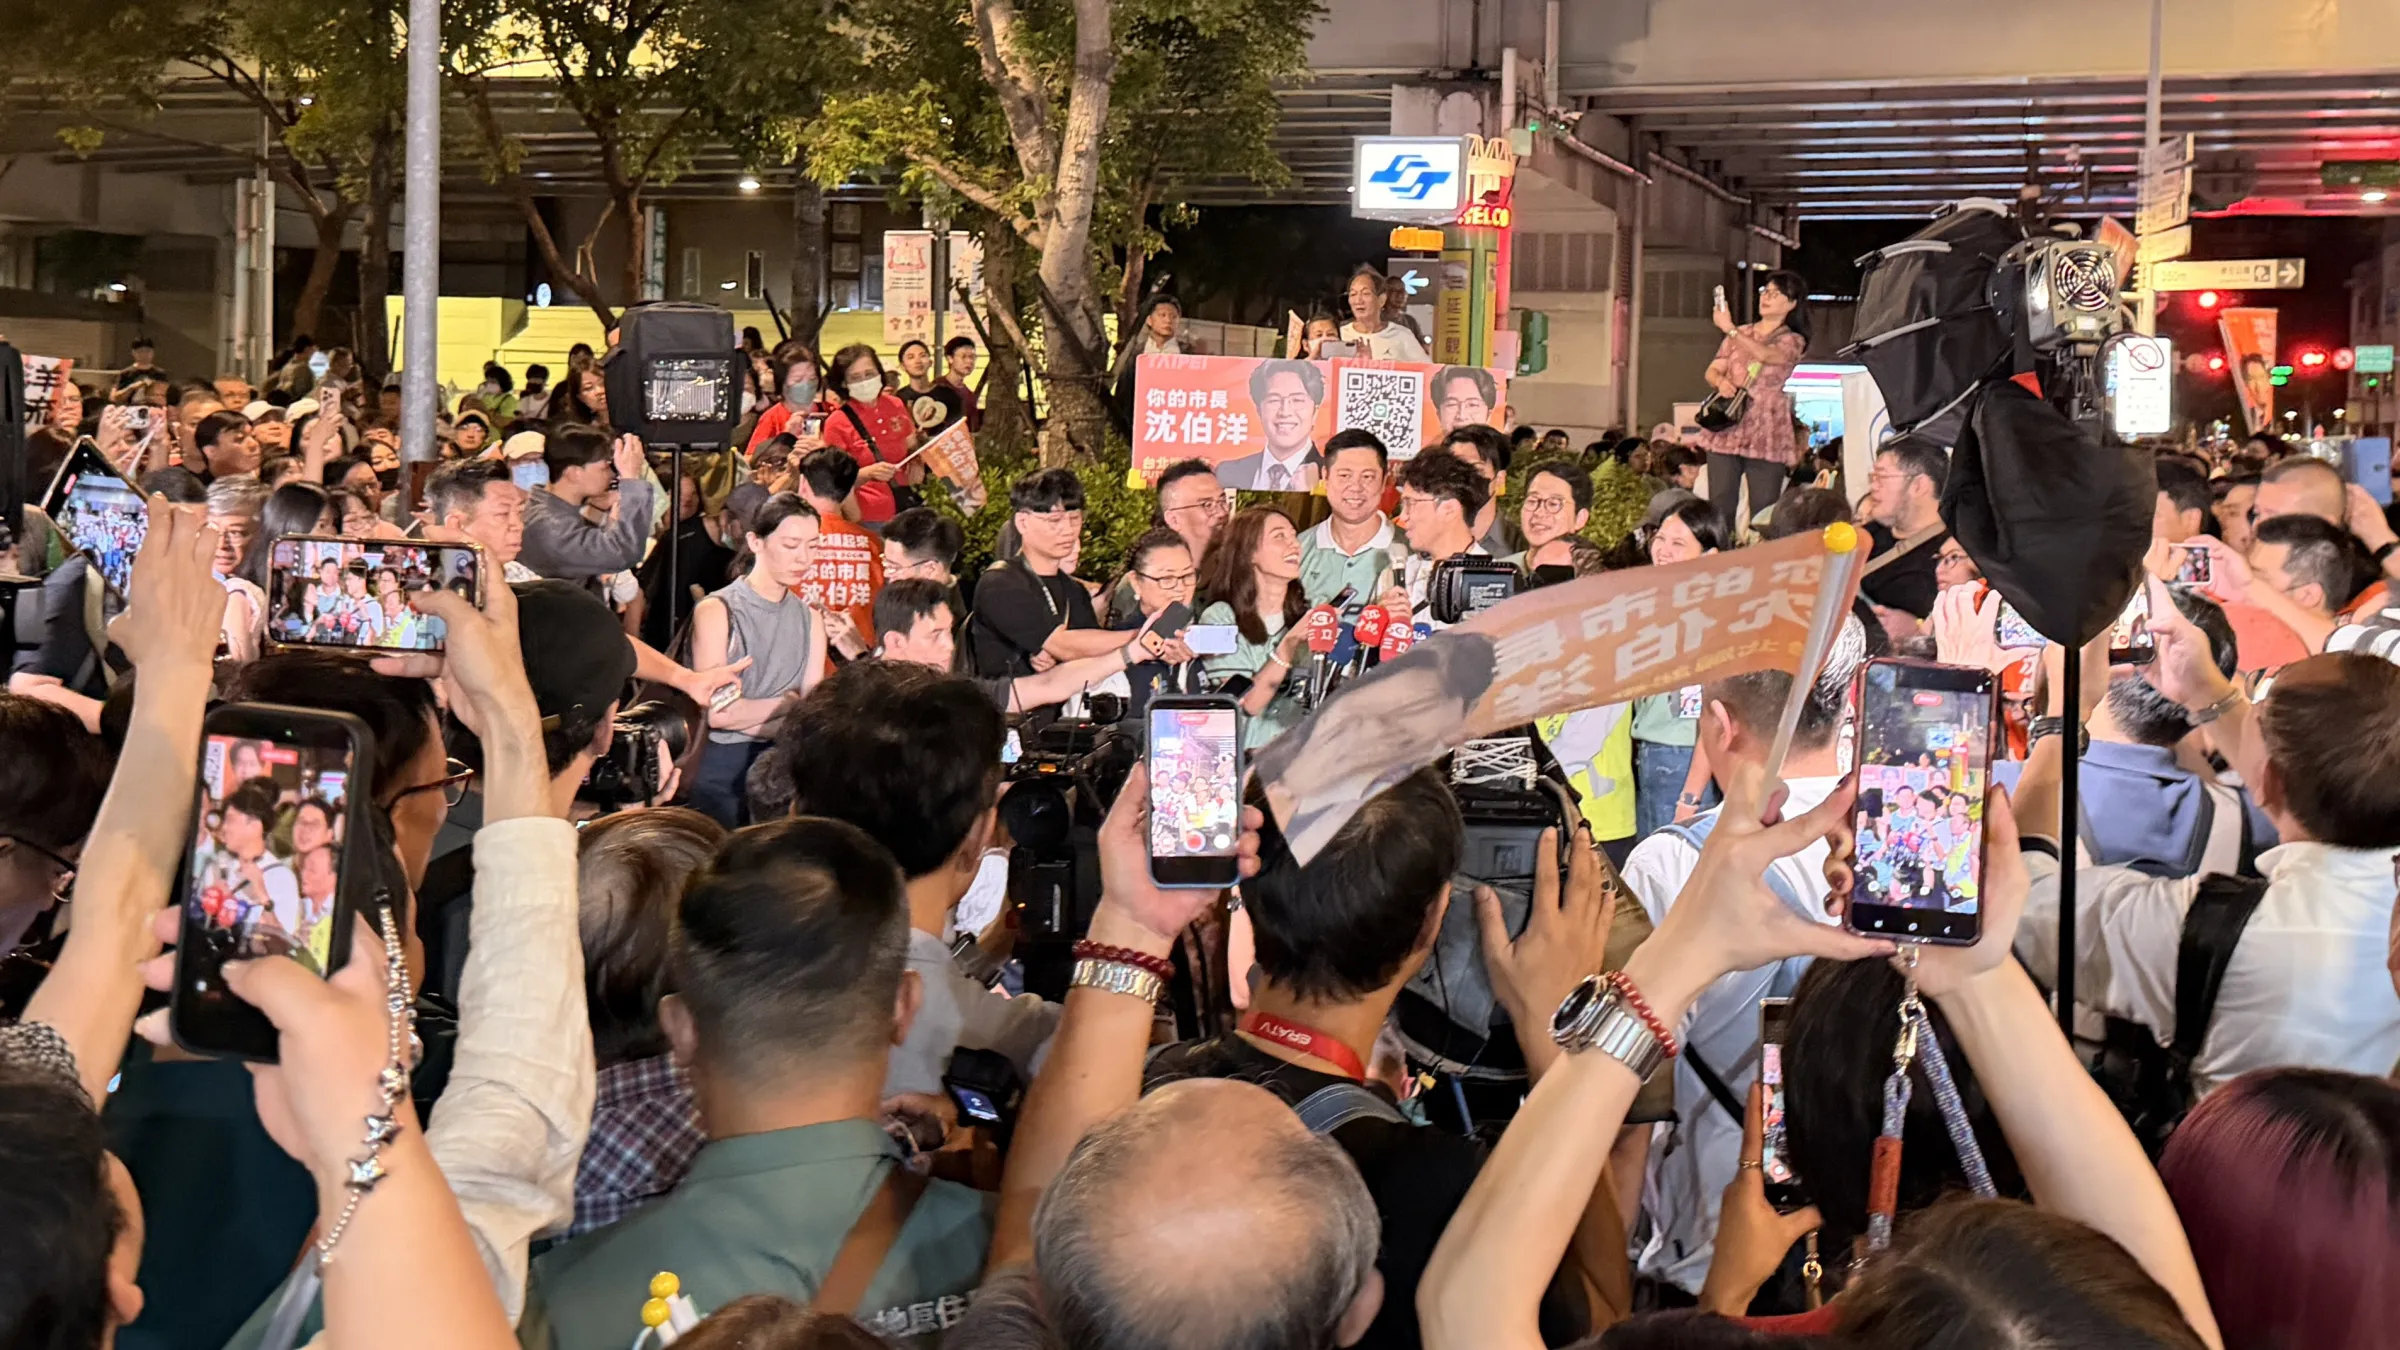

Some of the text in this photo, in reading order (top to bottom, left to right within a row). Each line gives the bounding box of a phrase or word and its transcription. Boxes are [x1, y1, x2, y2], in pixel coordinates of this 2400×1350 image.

[1146, 388, 1229, 409] 你的市長
[1143, 410, 1249, 445] 沈伯洋
[801, 581, 871, 606] 沈伯洋
